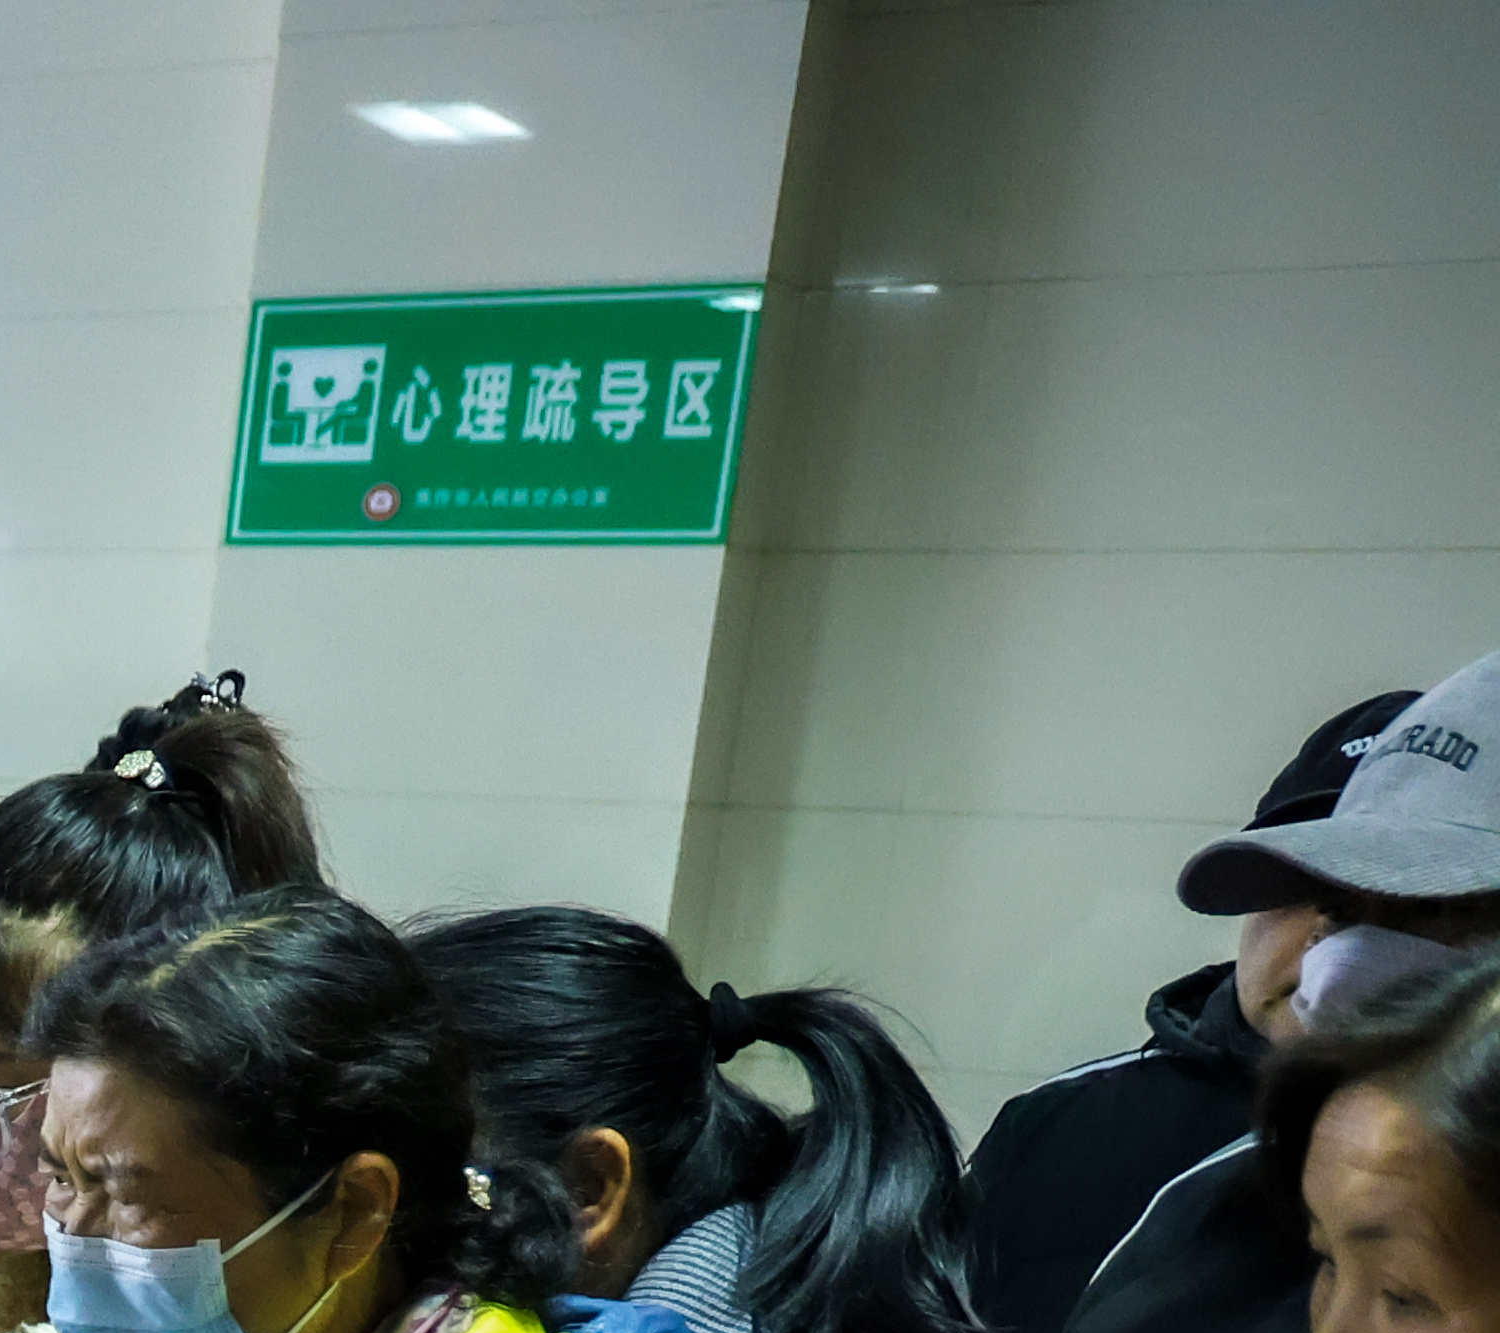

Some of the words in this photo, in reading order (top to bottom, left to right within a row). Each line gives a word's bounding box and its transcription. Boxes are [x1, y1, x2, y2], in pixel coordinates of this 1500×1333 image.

[390, 357, 723, 445] 心理疏导区
